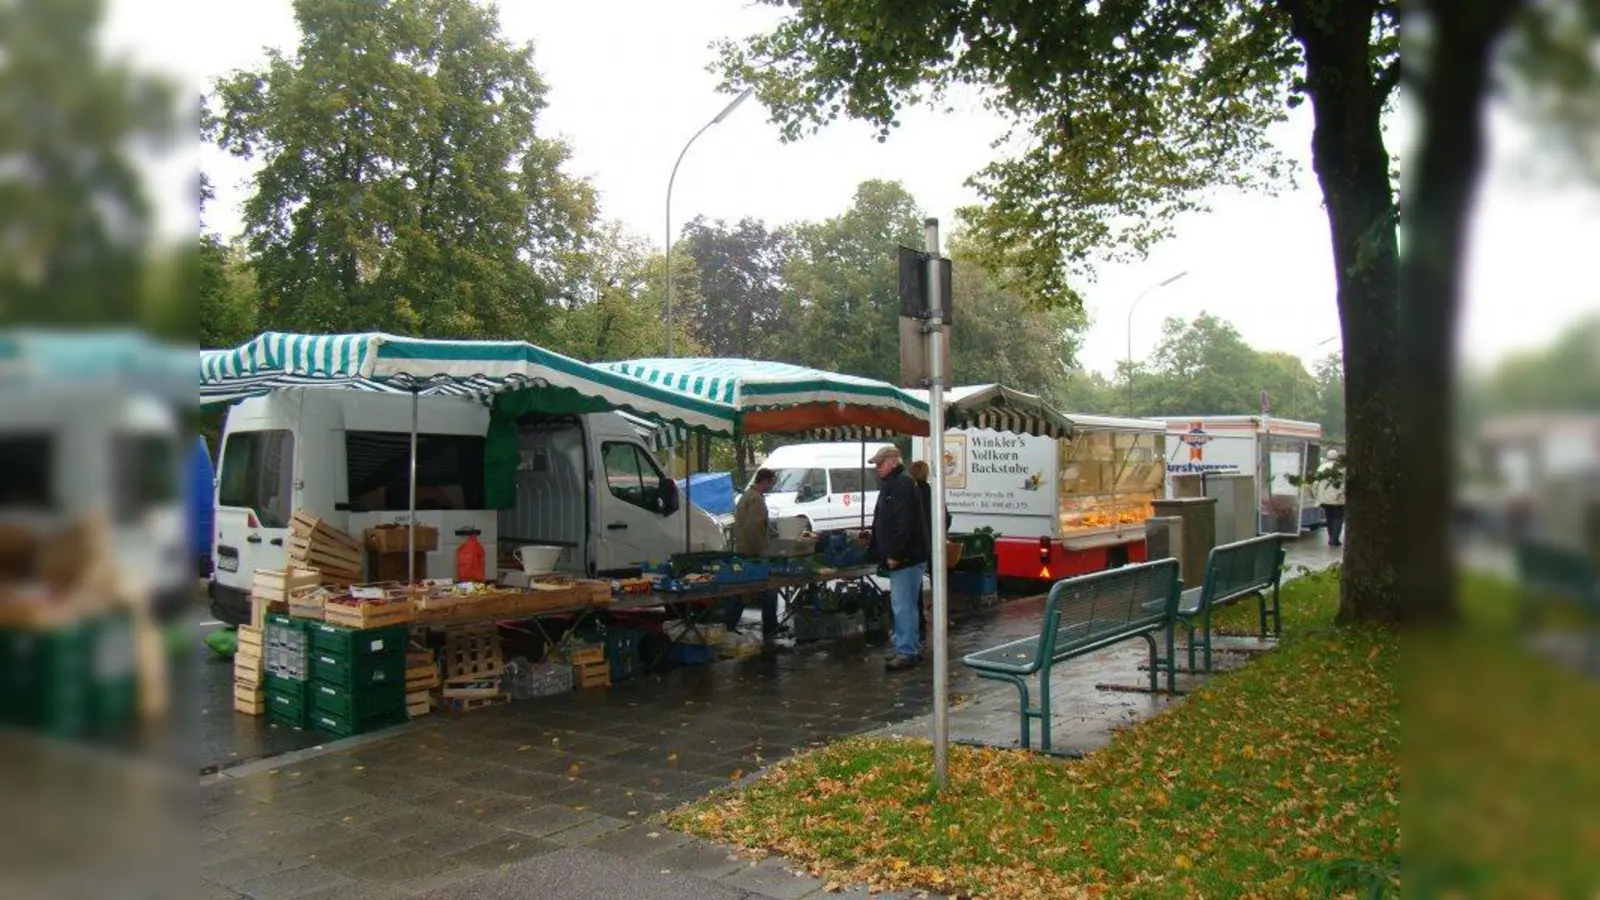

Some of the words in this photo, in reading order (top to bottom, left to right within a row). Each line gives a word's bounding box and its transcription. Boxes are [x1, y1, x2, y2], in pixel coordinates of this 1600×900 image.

[971, 437, 1026, 448] Winkler's
[971, 450, 1019, 461] Vollkorn
[971, 462, 1029, 474] Backstube
